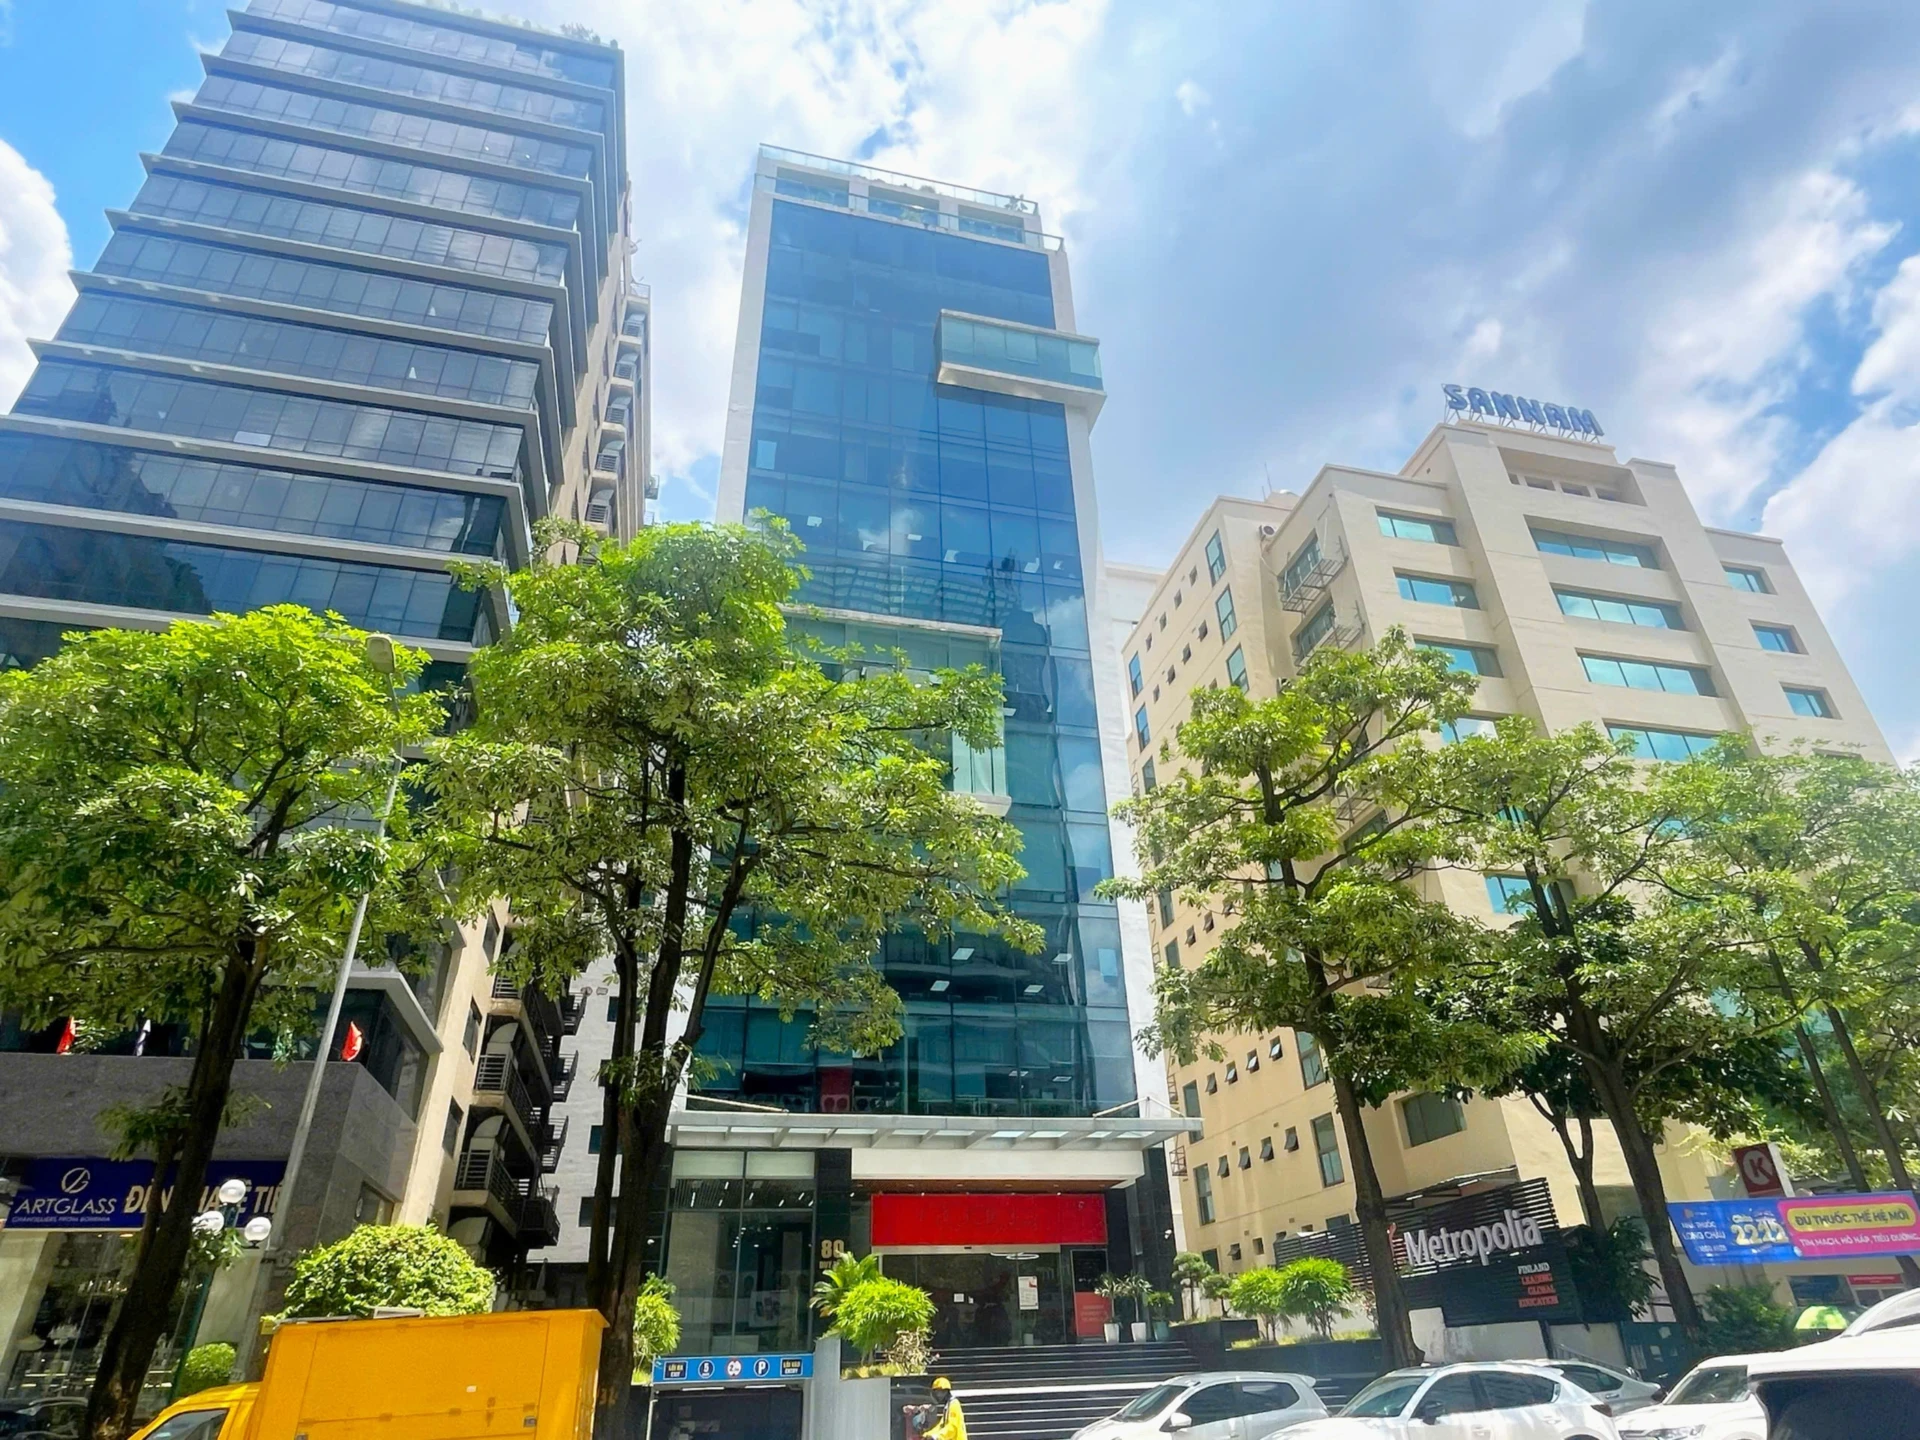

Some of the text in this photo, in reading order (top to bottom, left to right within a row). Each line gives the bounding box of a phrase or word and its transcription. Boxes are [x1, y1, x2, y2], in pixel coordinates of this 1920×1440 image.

[1443, 384, 1604, 436] SANNAM
[1749, 1157, 1768, 1178] K
[14, 1198, 117, 1214] ARTGLASS
[1795, 1208, 1910, 1226] ĐỦ THUỐC THẾ HỆ MỚI
[1403, 1209, 1543, 1266] Metropolia
[1517, 1262, 1550, 1275] FINLAND
[758, 1361, 766, 1374] P
